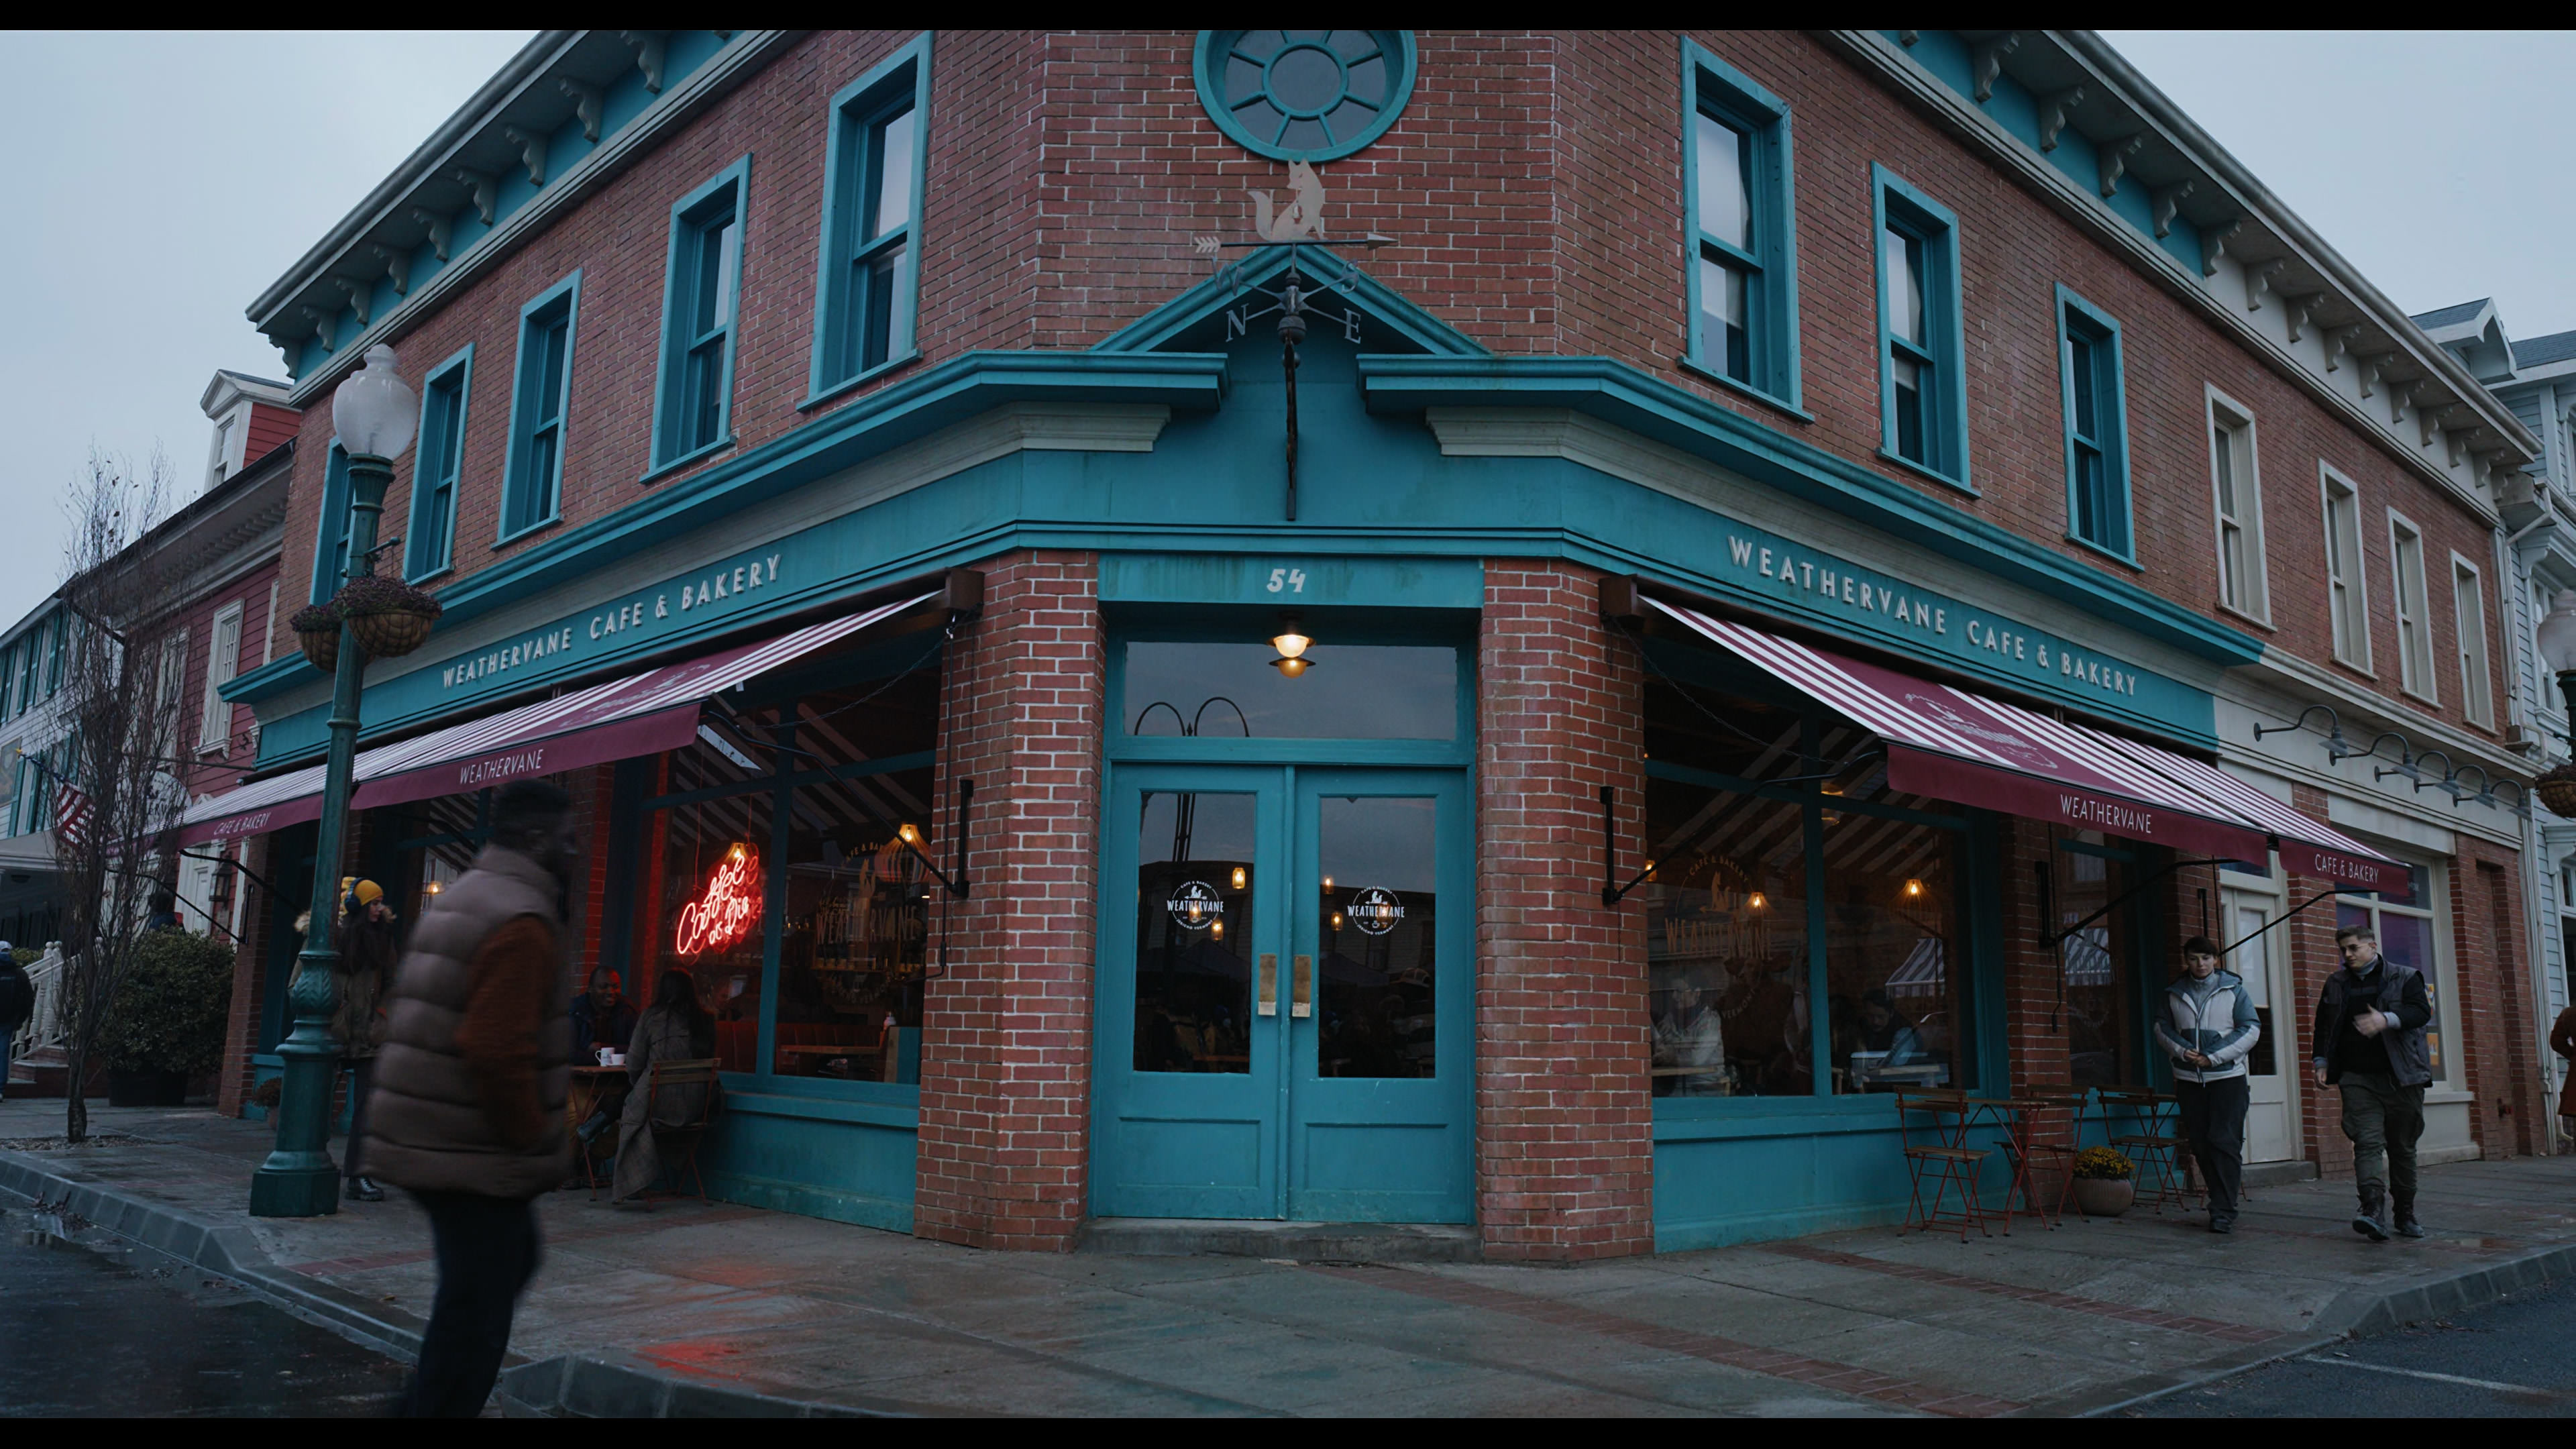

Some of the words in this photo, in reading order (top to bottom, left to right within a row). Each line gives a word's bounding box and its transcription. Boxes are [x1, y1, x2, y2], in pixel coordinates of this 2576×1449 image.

[1225, 303, 1250, 343] N
[1342, 307, 1362, 344] E
[1266, 568, 1306, 593] 54
[443, 627, 573, 688] WEATHERVANE
[590, 602, 644, 640] CAFE
[655, 594, 668, 619] &
[681, 553, 782, 610] BAKERY
[1727, 535, 1947, 635] WEATHERVANE
[1966, 620, 2025, 660] CAFE
[2037, 644, 2049, 669] &
[2060, 652, 2136, 696] BAKERY
[460, 749, 544, 784] WEATHERVANE
[213, 820, 236, 835] CAFE
[233, 818, 241, 833] &
[240, 812, 272, 832] BAKERY
[2060, 794, 2152, 834] WEATHERVANE
[2315, 853, 2337, 875] CAFE
[2340, 859, 2346, 877] &
[2349, 861, 2379, 884] BAKERY
[677, 855, 746, 955] Coffee
[1167, 900, 1224, 913] WEATHERVANE
[1347, 905, 1405, 918] WEATHERVANE
[816, 903, 918, 945] WEARVANE
